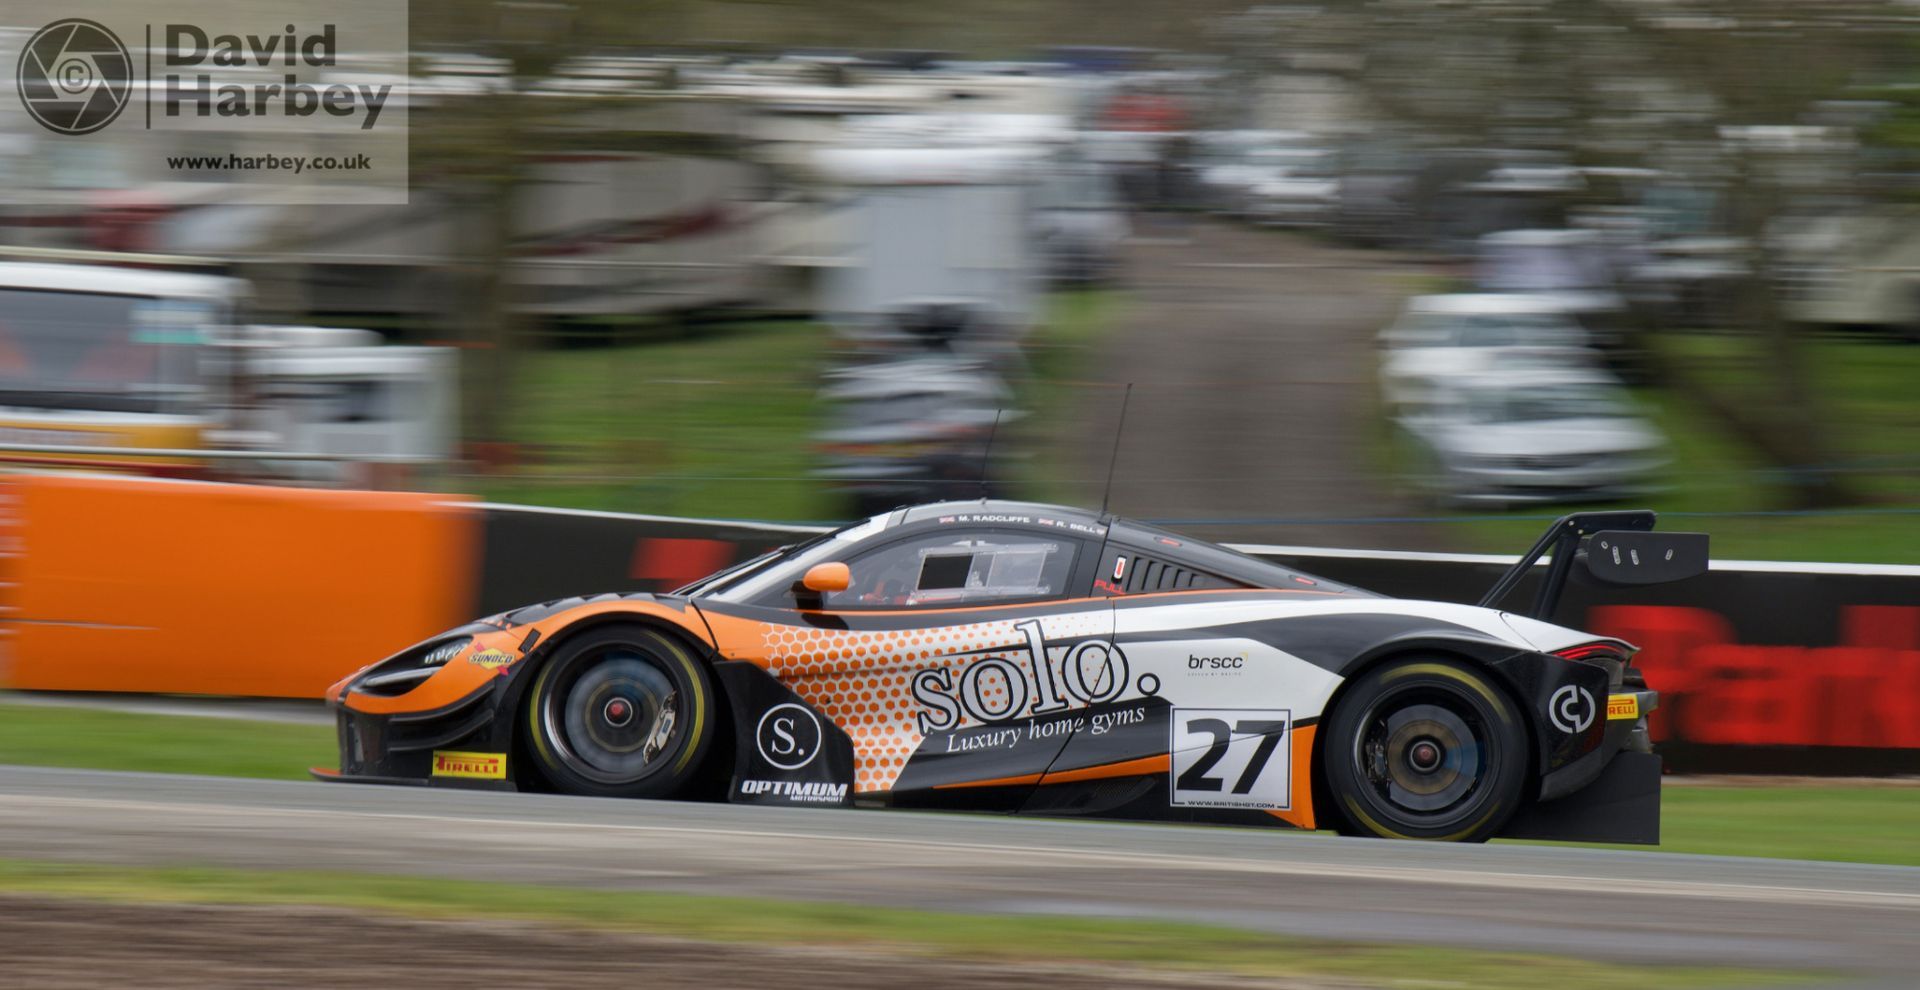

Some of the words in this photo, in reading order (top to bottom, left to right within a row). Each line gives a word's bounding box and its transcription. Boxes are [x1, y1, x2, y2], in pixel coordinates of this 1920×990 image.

[958, 515, 970, 523] M.
[973, 515, 1031, 524] RADCLIFFE
[1056, 521, 1067, 529] R.
[1070, 523, 1095, 534] BELL
[470, 653, 515, 665] SUNOCO
[1188, 654, 1244, 669] brscc
[911, 618, 1161, 736] solo.
[771, 717, 805, 755] S.
[946, 726, 1021, 753] Luxury
[1029, 717, 1085, 741] home
[1091, 705, 1146, 736] gyms
[437, 755, 500, 774] PIRELLI
[1176, 718, 1286, 795] 27
[741, 779, 849, 798] OPTIMUM
[789, 794, 843, 803] MOTORSPORT
